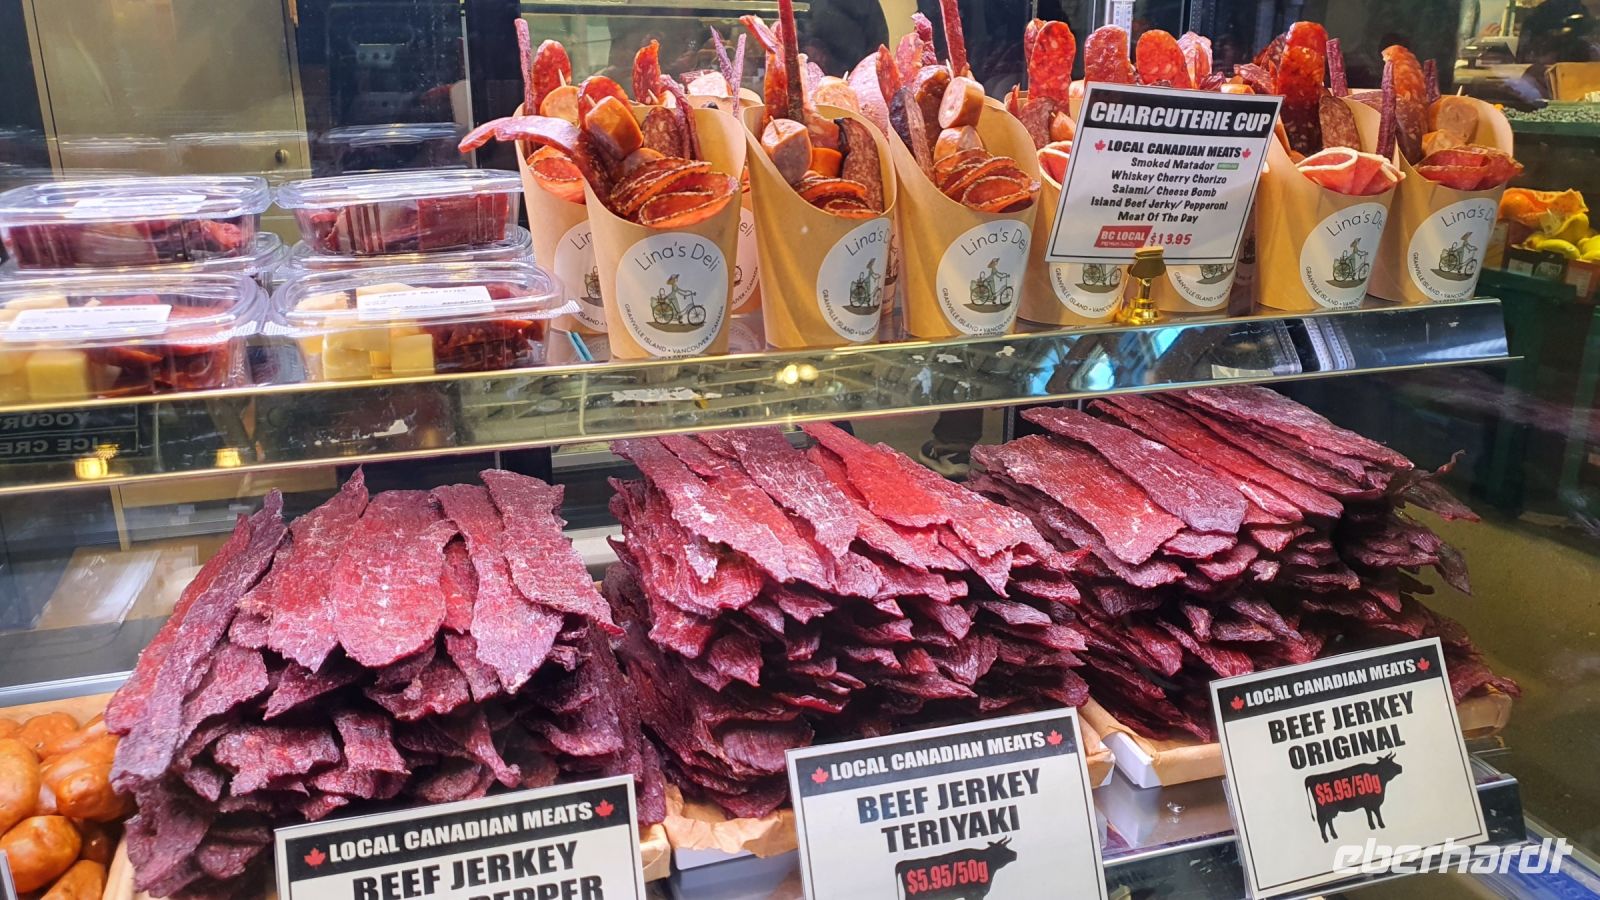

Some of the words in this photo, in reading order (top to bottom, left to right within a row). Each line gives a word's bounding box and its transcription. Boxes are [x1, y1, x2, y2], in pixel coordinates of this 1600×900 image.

[1090, 101, 1231, 131] CHARCUTERIE
[1233, 112, 1271, 132] CUP
[1107, 140, 1144, 153] LOCAL
[1147, 143, 1206, 157] CANADIAN
[1206, 146, 1242, 158] MEATS
[1131, 157, 1170, 169] Smoked
[1172, 159, 1214, 170] Matador
[1111, 170, 1154, 182] Whiskey
[1157, 172, 1190, 184] Cherry
[1192, 174, 1227, 184] Chorizo
[1112, 184, 1154, 195] Salami/
[1156, 186, 1189, 196] Cheese
[1191, 187, 1217, 197] Bomb
[1091, 196, 1123, 207] Island
[1124, 198, 1146, 208] Beef
[1149, 199, 1182, 211] Jerky/
[1184, 200, 1228, 212] Pepperoni
[1117, 211, 1145, 221] Meat
[1147, 212, 1160, 222] Of
[1161, 213, 1178, 222] The
[1180, 214, 1199, 224] Day
[1441, 205, 1485, 228] Lina's
[740, 222, 755, 237] eli
[1101, 231, 1115, 240] BC
[1117, 231, 1145, 240] LOCAL
[1150, 232, 1192, 246] $13.95
[1326, 210, 1371, 237] Lina's
[635, 241, 686, 271] Lina's
[690, 243, 720, 272] Deli
[845, 226, 884, 256] Lina's
[961, 227, 1009, 255] Lina's
[1055, 267, 1071, 298] GRANVILLE
[1069, 296, 1089, 311] ISLAND
[1174, 271, 1196, 297] GRANVILLE
[1194, 293, 1213, 302] ISLAND
[1306, 266, 1321, 296] GRANVILLE
[1320, 292, 1339, 306] ISLAND
[822, 289, 838, 322] GRANVILLE
[836, 319, 855, 335] ISLAND
[942, 287, 960, 320] GRANVILLE
[958, 317, 979, 332] ISLAND
[624, 303, 645, 339] GRANVILLE
[643, 335, 667, 353] ISLAND
[672, 337, 710, 354] VANCOUVER
[1245, 685, 1291, 708] LOCAL
[1293, 668, 1367, 698] CANADIAN
[1369, 659, 1416, 682] MEATS
[1268, 710, 1326, 744] BEEF
[1333, 691, 1415, 730] JERKEY
[831, 758, 888, 781] LOCAL
[892, 741, 984, 770] CANADIAN
[987, 731, 1045, 756] MEATS
[1289, 724, 1406, 770] ORIGINAL
[857, 786, 929, 824] BEEF
[937, 768, 1040, 811] JERKEY
[1315, 773, 1381, 806] $5.95/50g
[329, 836, 400, 863] LOCAL
[404, 815, 518, 851] CANADIAN
[523, 801, 592, 831] MEATS
[881, 805, 1020, 853] TERIYAKI
[352, 864, 440, 900] BEEF
[451, 840, 577, 890] JERKEY
[907, 859, 989, 896] $5.95/50g
